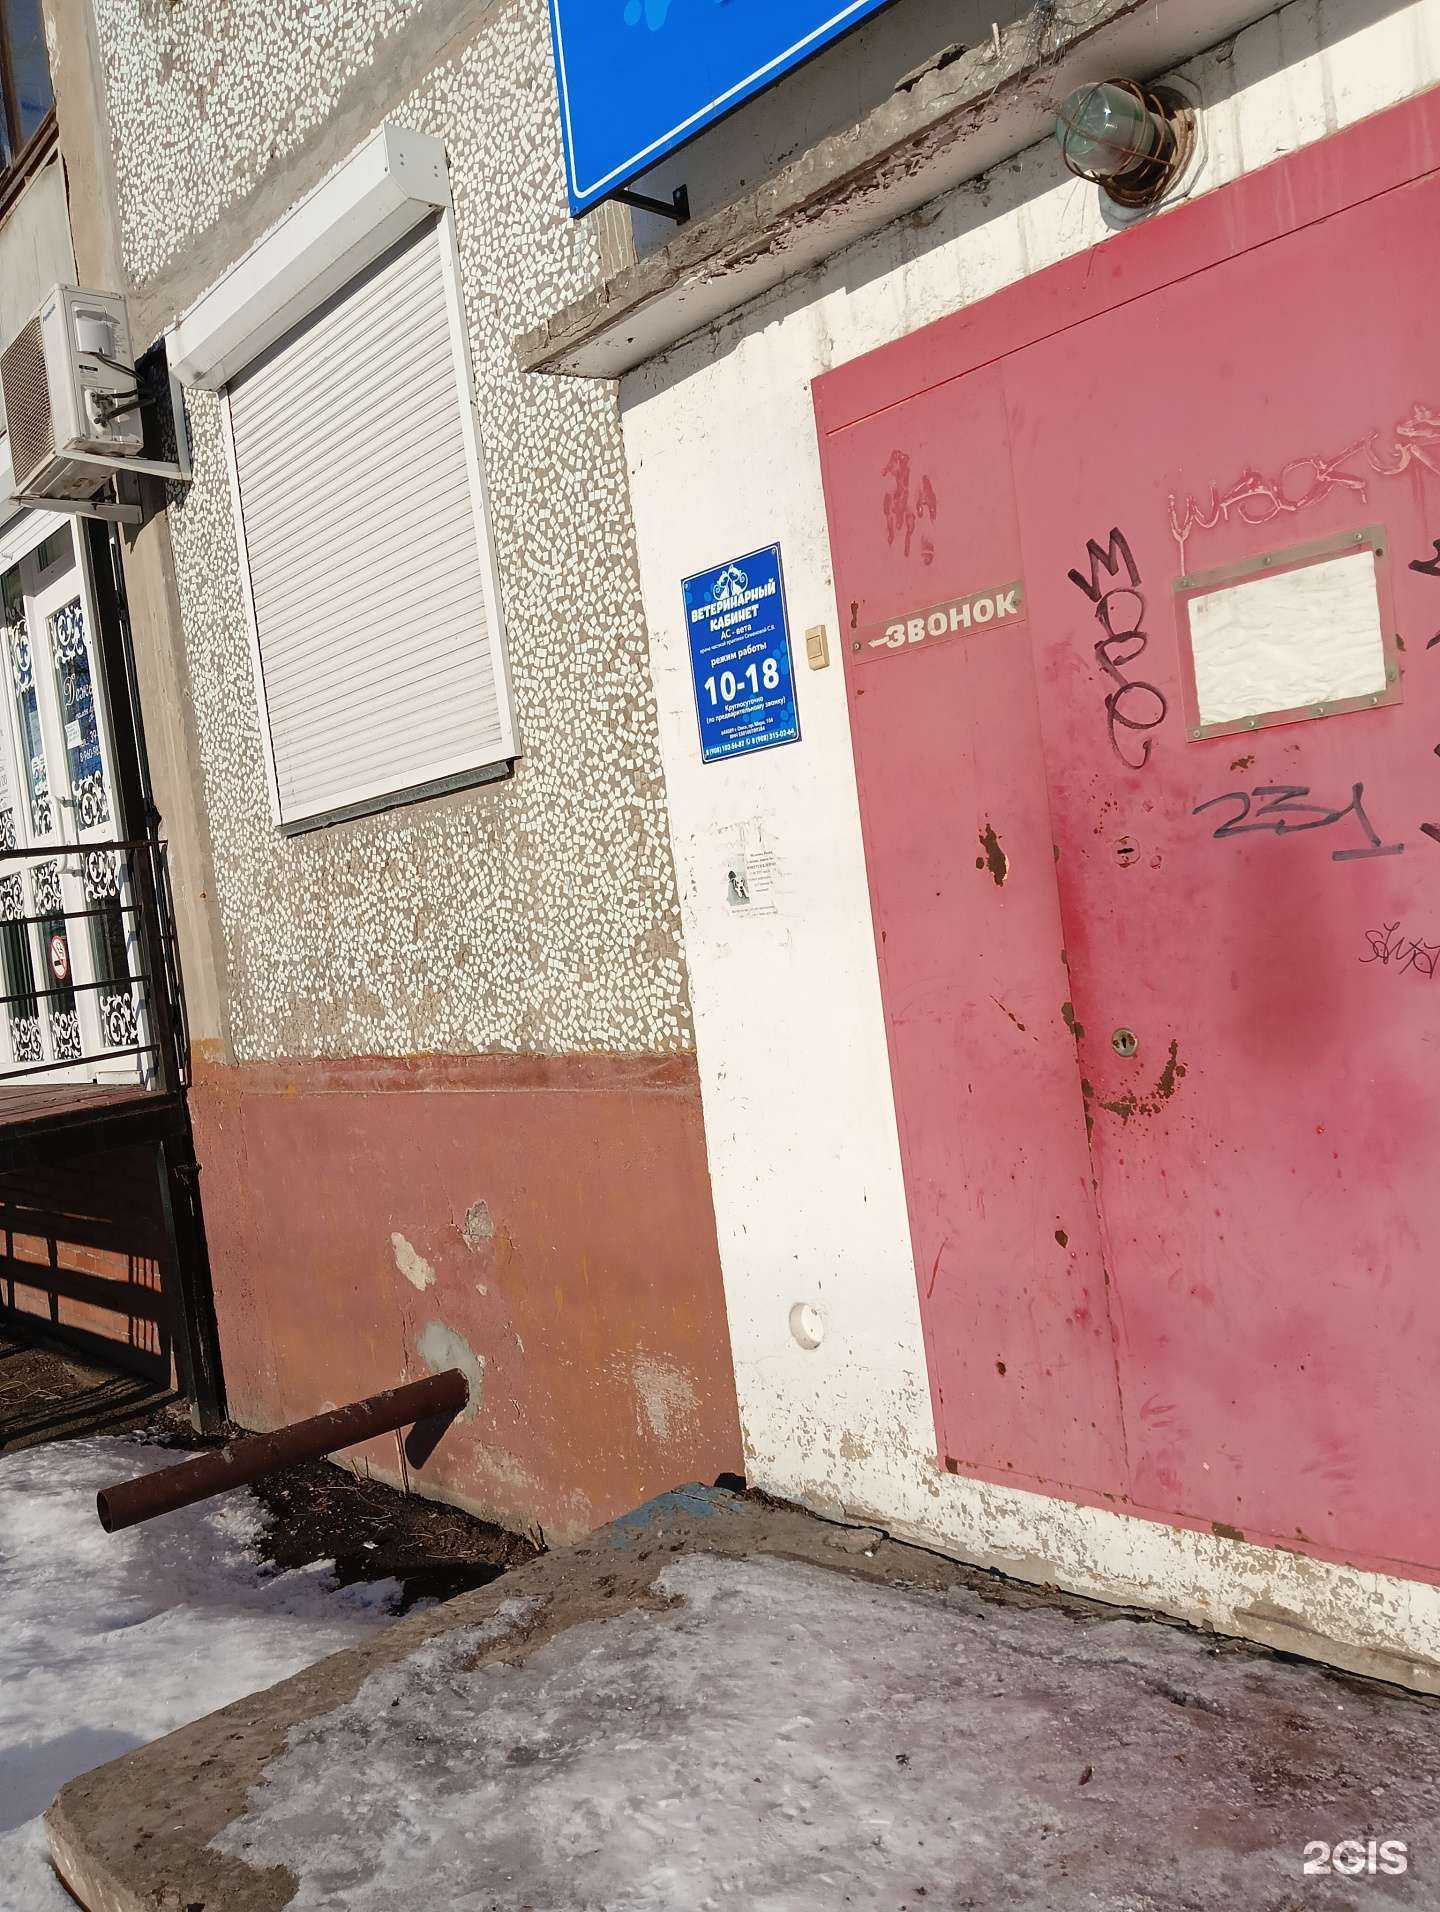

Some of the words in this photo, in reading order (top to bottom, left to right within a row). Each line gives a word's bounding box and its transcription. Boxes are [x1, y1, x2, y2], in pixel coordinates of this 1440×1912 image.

[691, 578, 776, 623] ВЕТЕРИНАРНЫЙ
[710, 604, 759, 632] КАБИНЕТ
[721, 628, 731, 640] АС
[736, 623, 751, 634] вета
[885, 590, 1018, 649] ЗВОНОК
[711, 653, 737, 667] режим
[738, 642, 767, 659] работы
[704, 658, 779, 705] 10-18
[706, 716, 714, 724] (по
[715, 704, 764, 721] предварительному
[765, 696, 785, 708] звонку)
[725, 696, 763, 711] Круглосуточно
